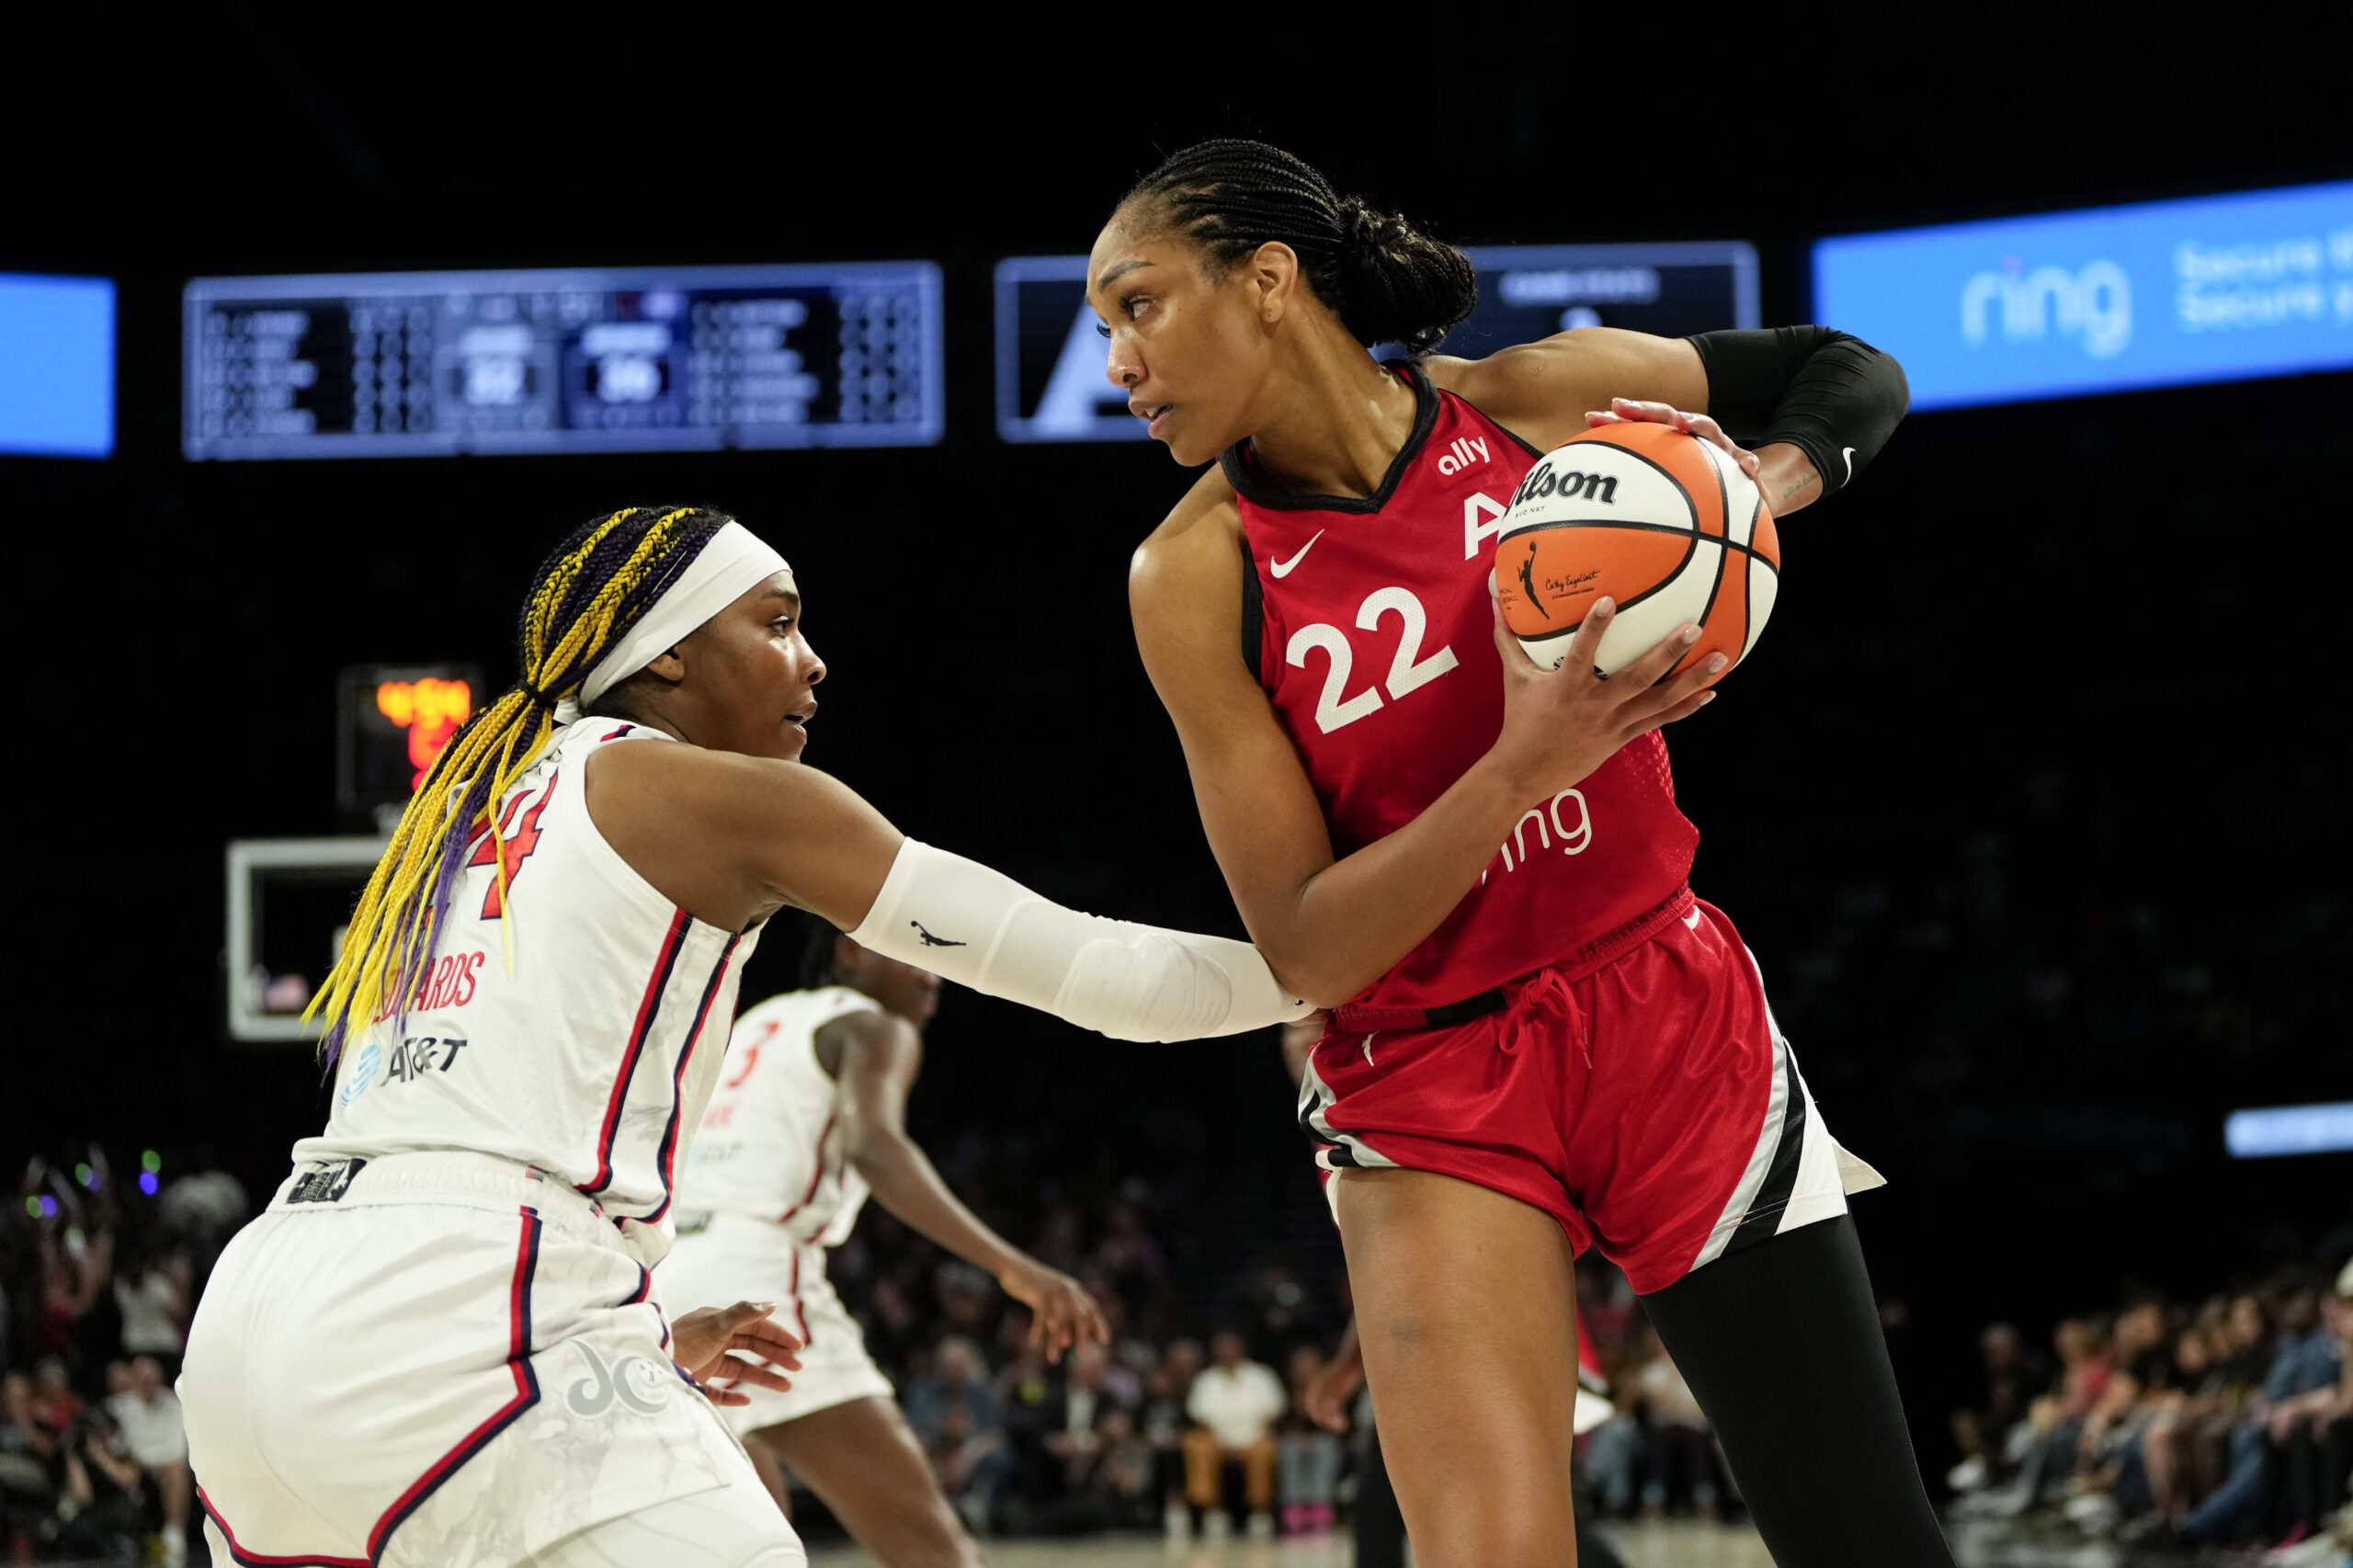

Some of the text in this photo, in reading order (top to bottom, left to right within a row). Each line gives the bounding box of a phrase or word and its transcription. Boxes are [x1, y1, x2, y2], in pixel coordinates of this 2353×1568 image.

[1961, 255, 2133, 359] ring
[1438, 436, 1491, 476] ally
[1504, 461, 1619, 517] ilson
[1530, 506, 1545, 514] NXT
[1286, 586, 1460, 734] 22
[1482, 789, 1592, 885] ing
[379, 1037, 468, 1087] AT&T
